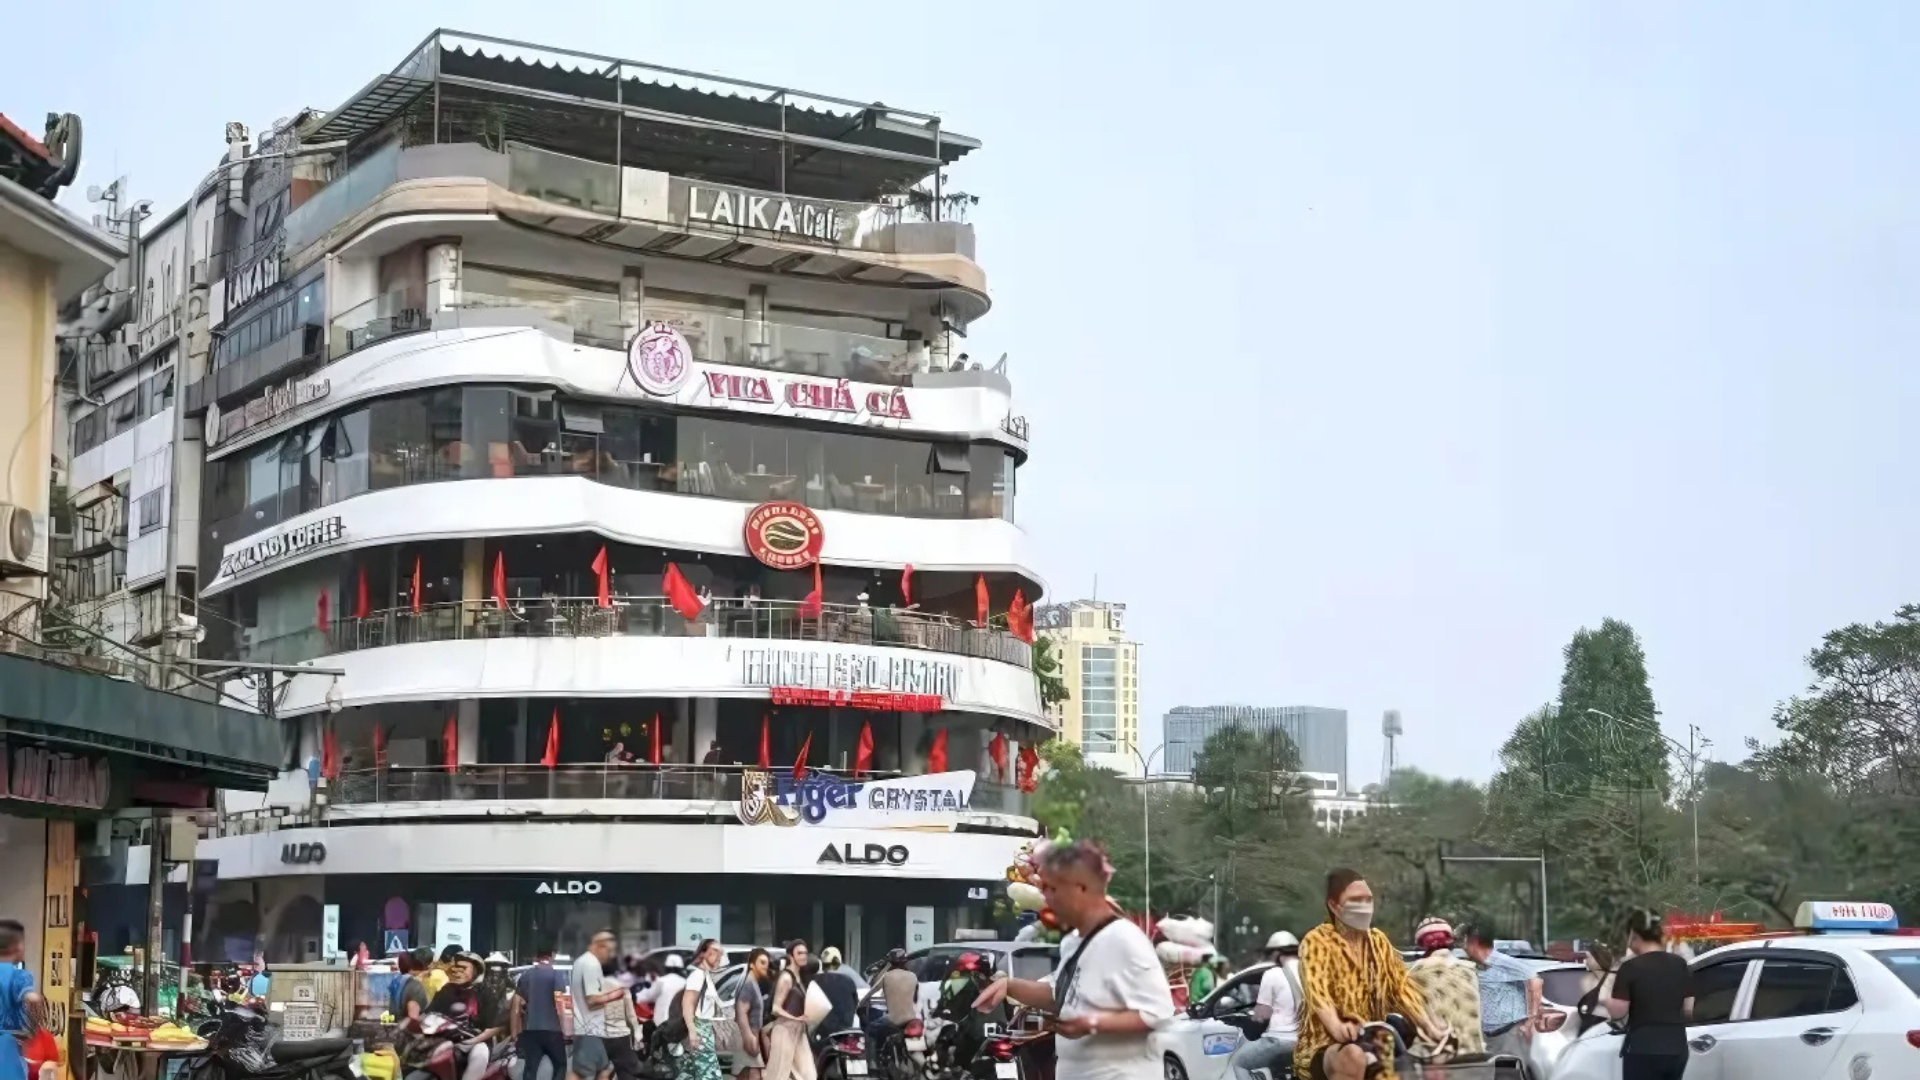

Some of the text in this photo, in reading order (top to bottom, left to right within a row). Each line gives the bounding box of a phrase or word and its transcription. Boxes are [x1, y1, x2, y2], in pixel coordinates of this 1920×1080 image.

[690, 187, 797, 234] LAIKA
[869, 787, 969, 812] CRYSTAL
[816, 841, 909, 866] ALDO
[535, 880, 602, 894] ALDO
